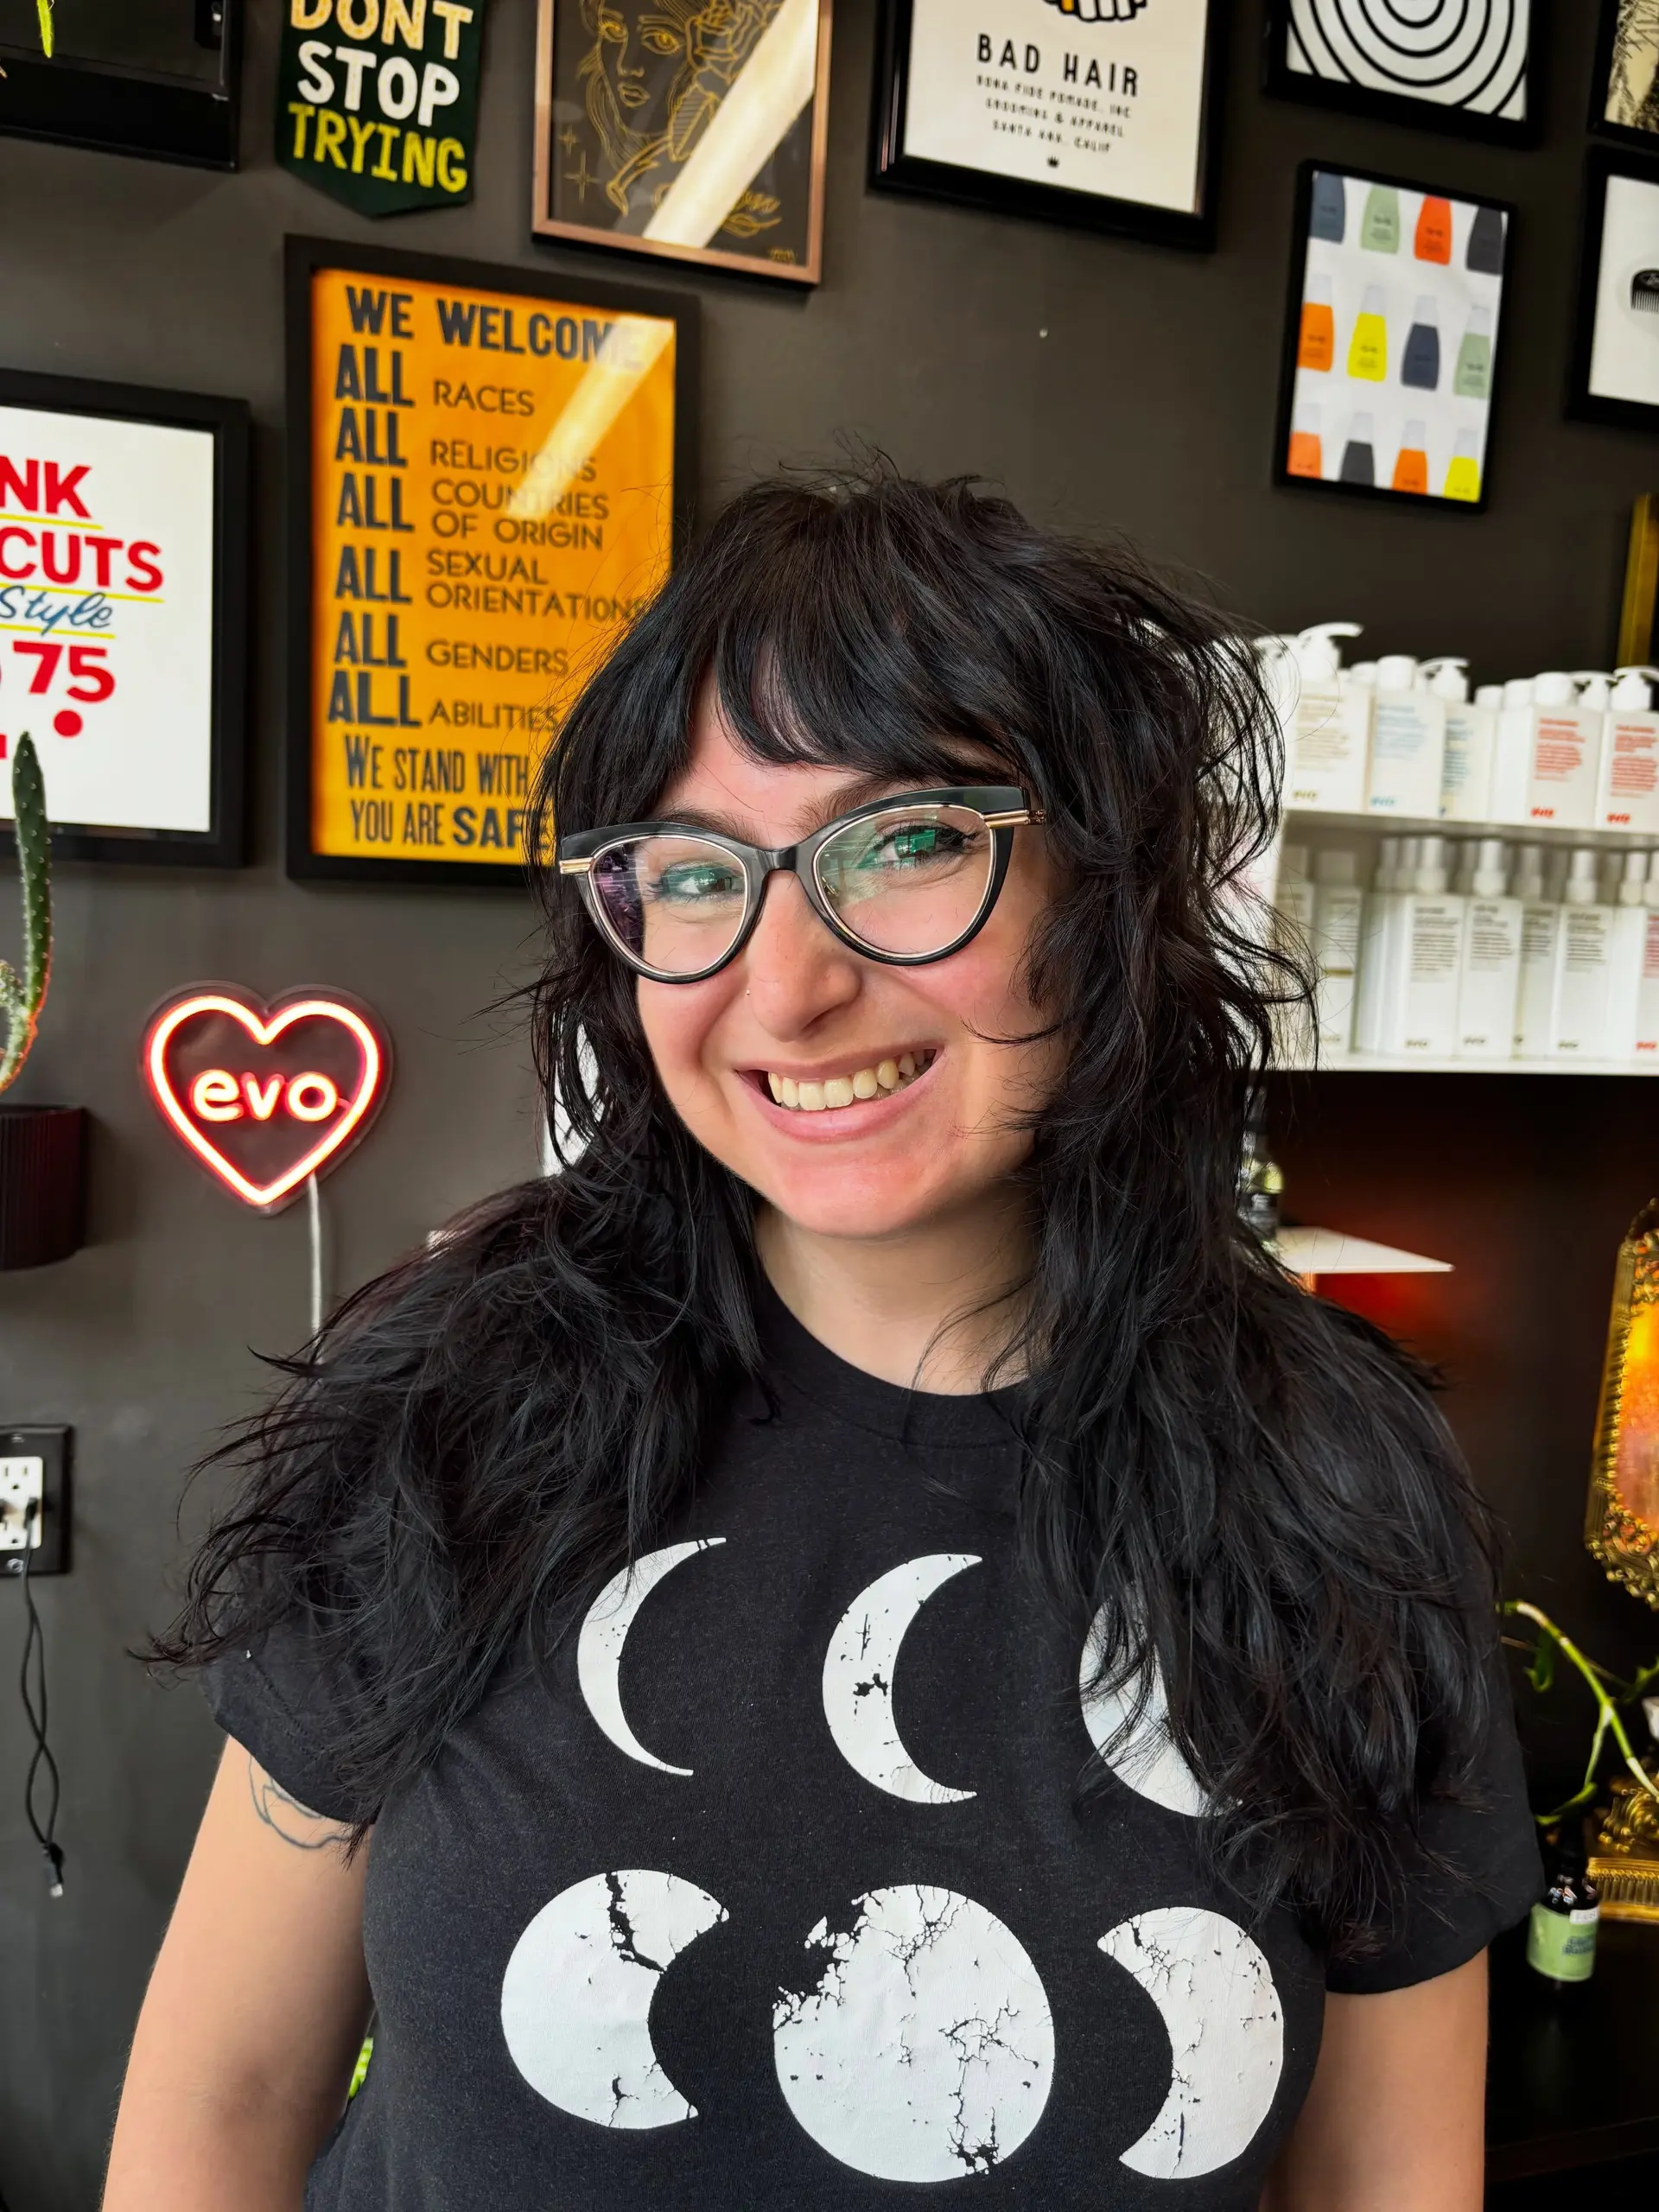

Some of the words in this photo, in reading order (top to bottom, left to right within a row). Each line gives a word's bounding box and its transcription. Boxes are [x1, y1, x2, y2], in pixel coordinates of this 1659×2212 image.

[290, 0, 474, 60] DONT
[297, 40, 460, 127] STOP
[977, 34, 1041, 74] BAD
[1064, 53, 1138, 97] HAIR
[288, 102, 467, 193] TRYING
[346, 285, 414, 340] WE
[437, 299, 645, 370] WELCOME
[335, 345, 415, 407] ALL
[434, 380, 535, 417] RACES
[335, 408, 408, 468] ALL
[336, 473, 415, 532] ALL
[431, 511, 478, 538] OF
[493, 517, 603, 551] ORIGIN
[0, 526, 163, 592] CUTS
[335, 546, 412, 603] ALL
[427, 551, 548, 585] SEXUAL
[0, 585, 112, 635] Style
[334, 612, 406, 667] ALL
[425, 639, 569, 676] GENDERS
[327, 671, 422, 728] ALL
[429, 699, 557, 732] ABILITIES
[394, 747, 465, 794] STAND
[478, 753, 529, 798] WITH
[351, 800, 393, 842] YOU
[404, 803, 444, 846] ARE
[190, 1069, 339, 1122] evo
